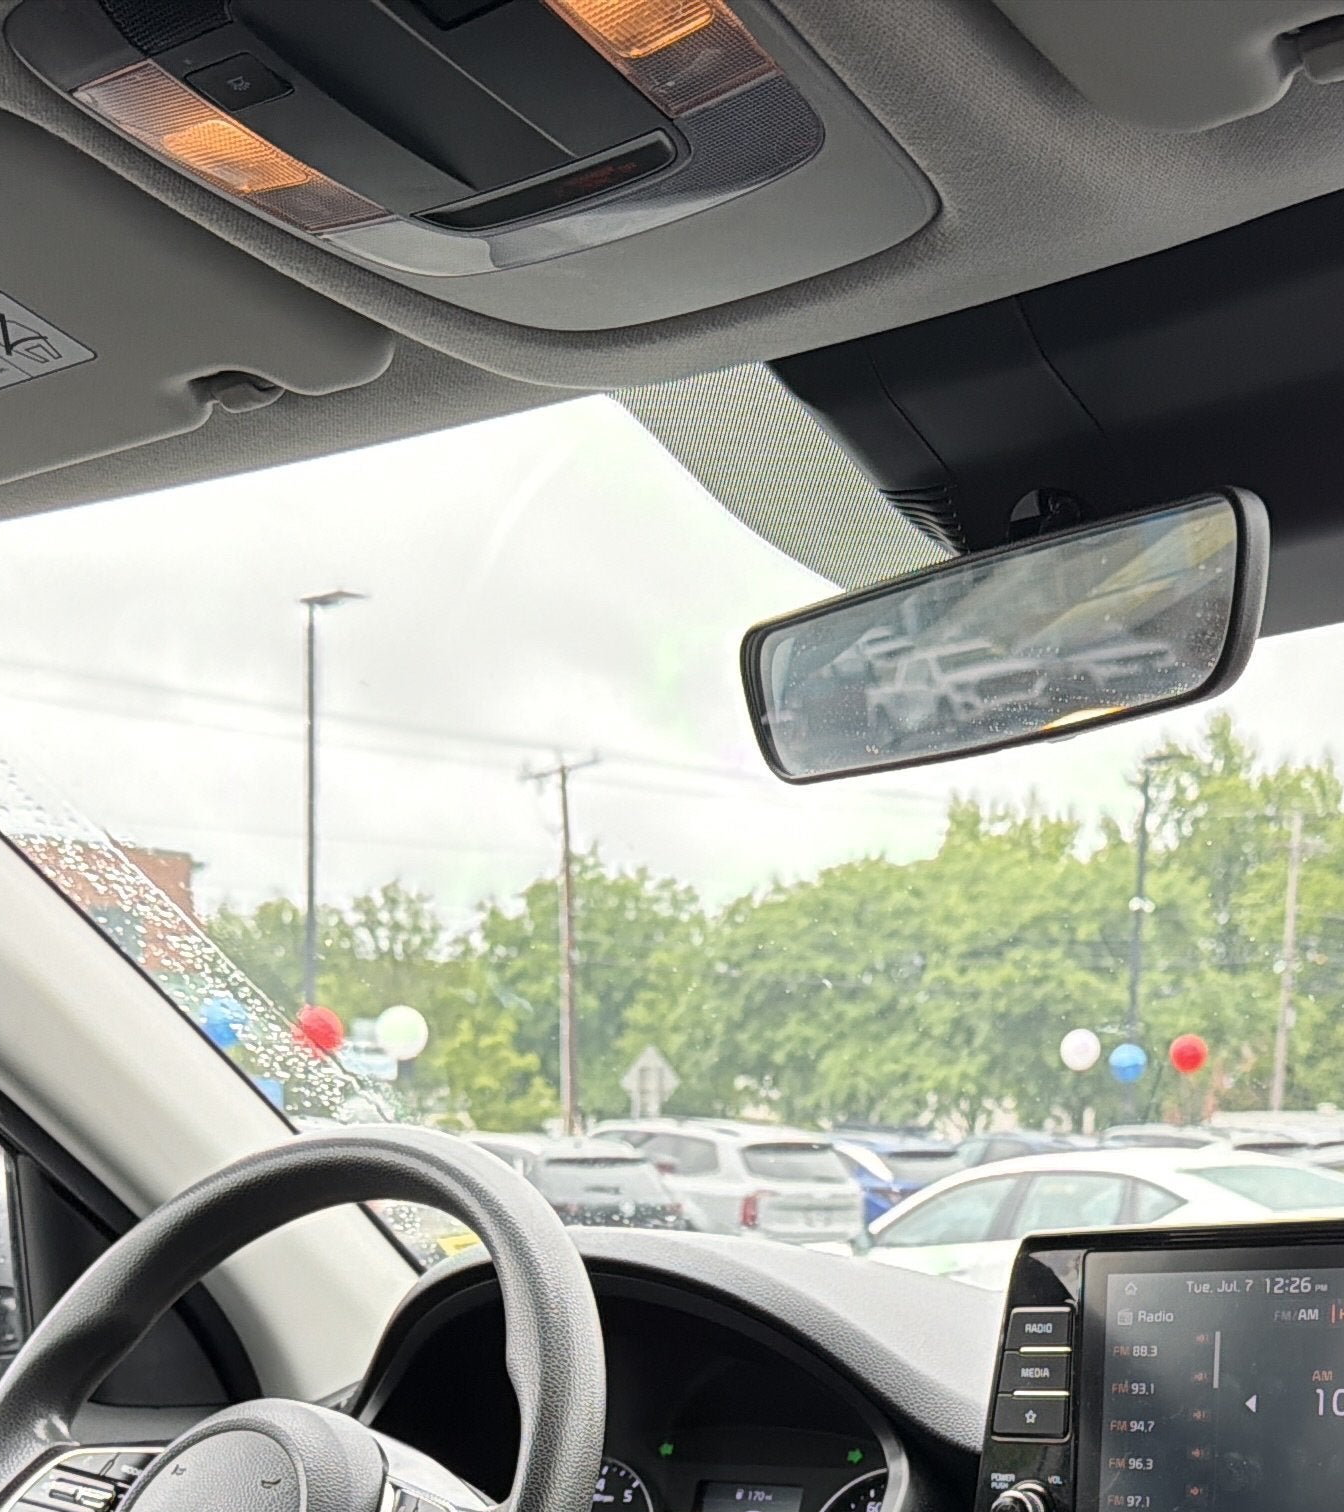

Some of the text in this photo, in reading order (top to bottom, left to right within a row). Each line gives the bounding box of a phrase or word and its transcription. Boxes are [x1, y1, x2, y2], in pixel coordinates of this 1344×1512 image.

[1245, 1279, 1254, 1292] 7
[1264, 1277, 1312, 1294] 12:26
[1315, 1283, 1328, 1292] PM
[1137, 1310, 1174, 1324] Radio
[1024, 1322, 1053, 1334] RADIO
[1113, 1345, 1158, 1357] FM 88.3
[1020, 1367, 1050, 1378] MEDIA
[1312, 1370, 1333, 1382] AM
[1111, 1382, 1155, 1395] FM 93.1
[1110, 1420, 1155, 1433] FM 94.7
[1108, 1458, 1154, 1470] FM 96.3
[991, 1473, 1016, 1482] POWER
[1047, 1475, 1063, 1485] VOL
[595, 1478, 606, 1492] 4
[991, 1481, 1009, 1490] PUSH
[622, 1489, 633, 1503] 5
[747, 1490, 766, 1501] 170
[1107, 1495, 1151, 1508] FM 97.1
